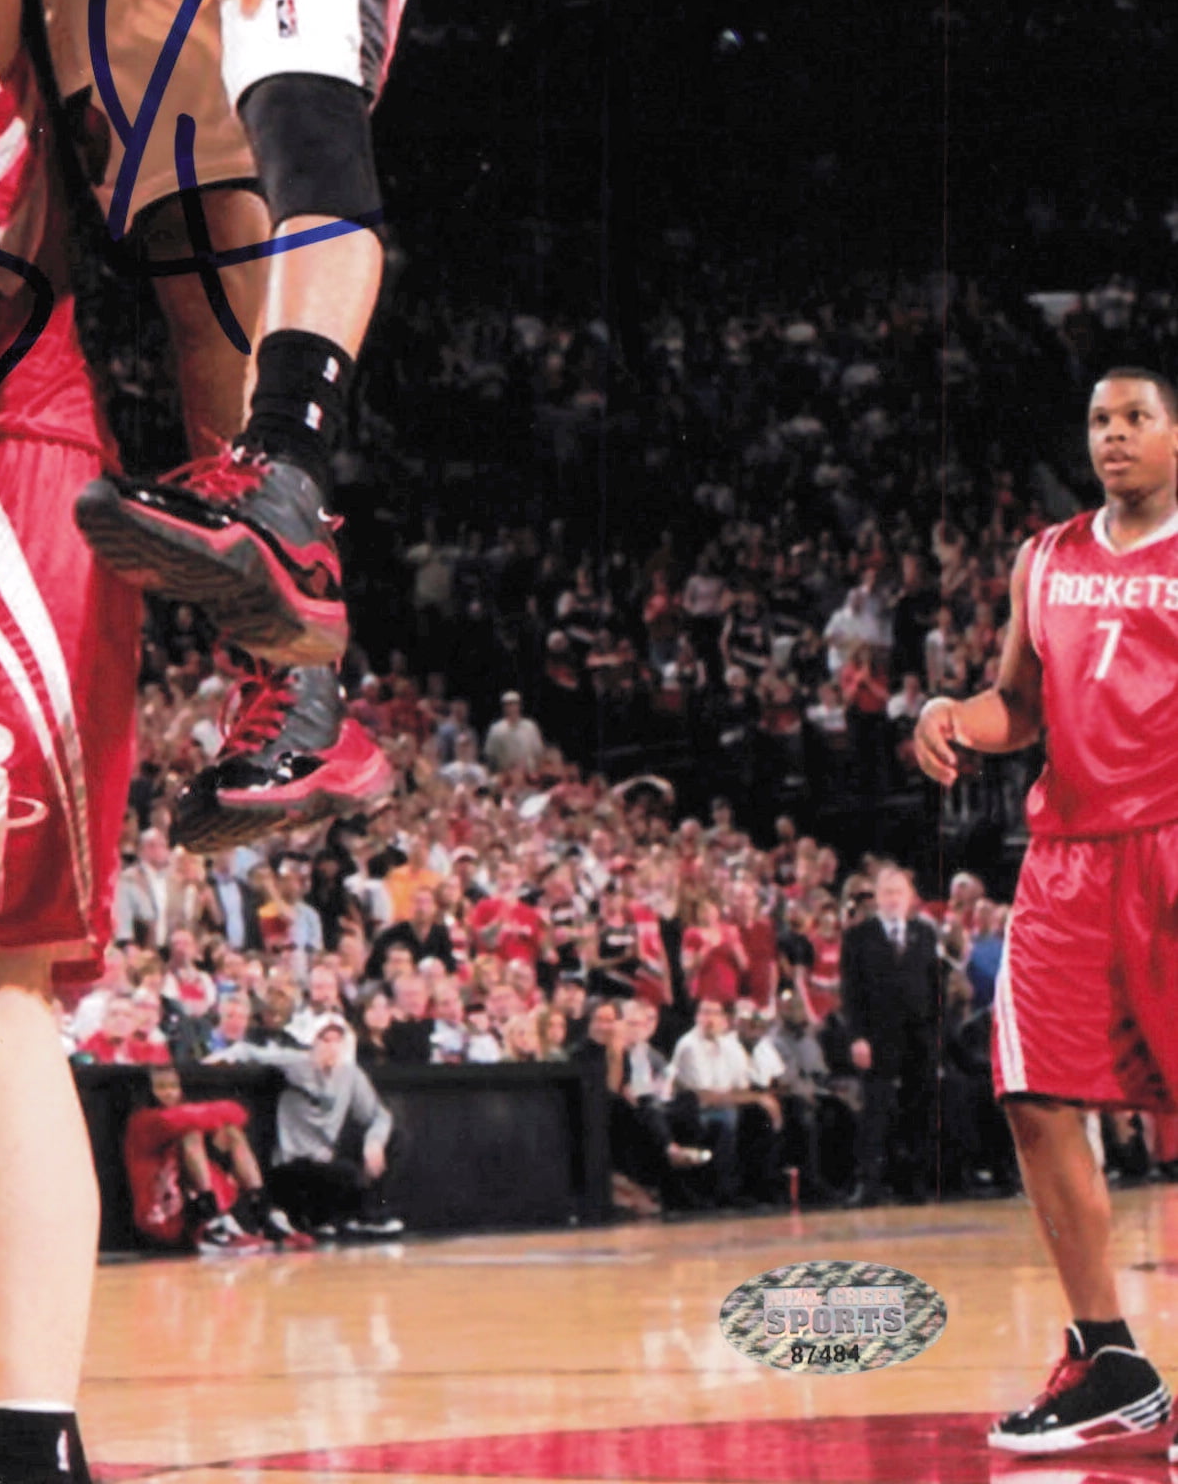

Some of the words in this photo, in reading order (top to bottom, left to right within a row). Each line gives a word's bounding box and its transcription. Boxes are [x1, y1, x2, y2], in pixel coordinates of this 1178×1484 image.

[1048, 571, 1178, 611] ROCKETS
[1094, 619, 1122, 681] 7
[829, 1287, 901, 1305] CREEK
[766, 1307, 903, 1335] SPORTS
[791, 1344, 861, 1365] 87484
